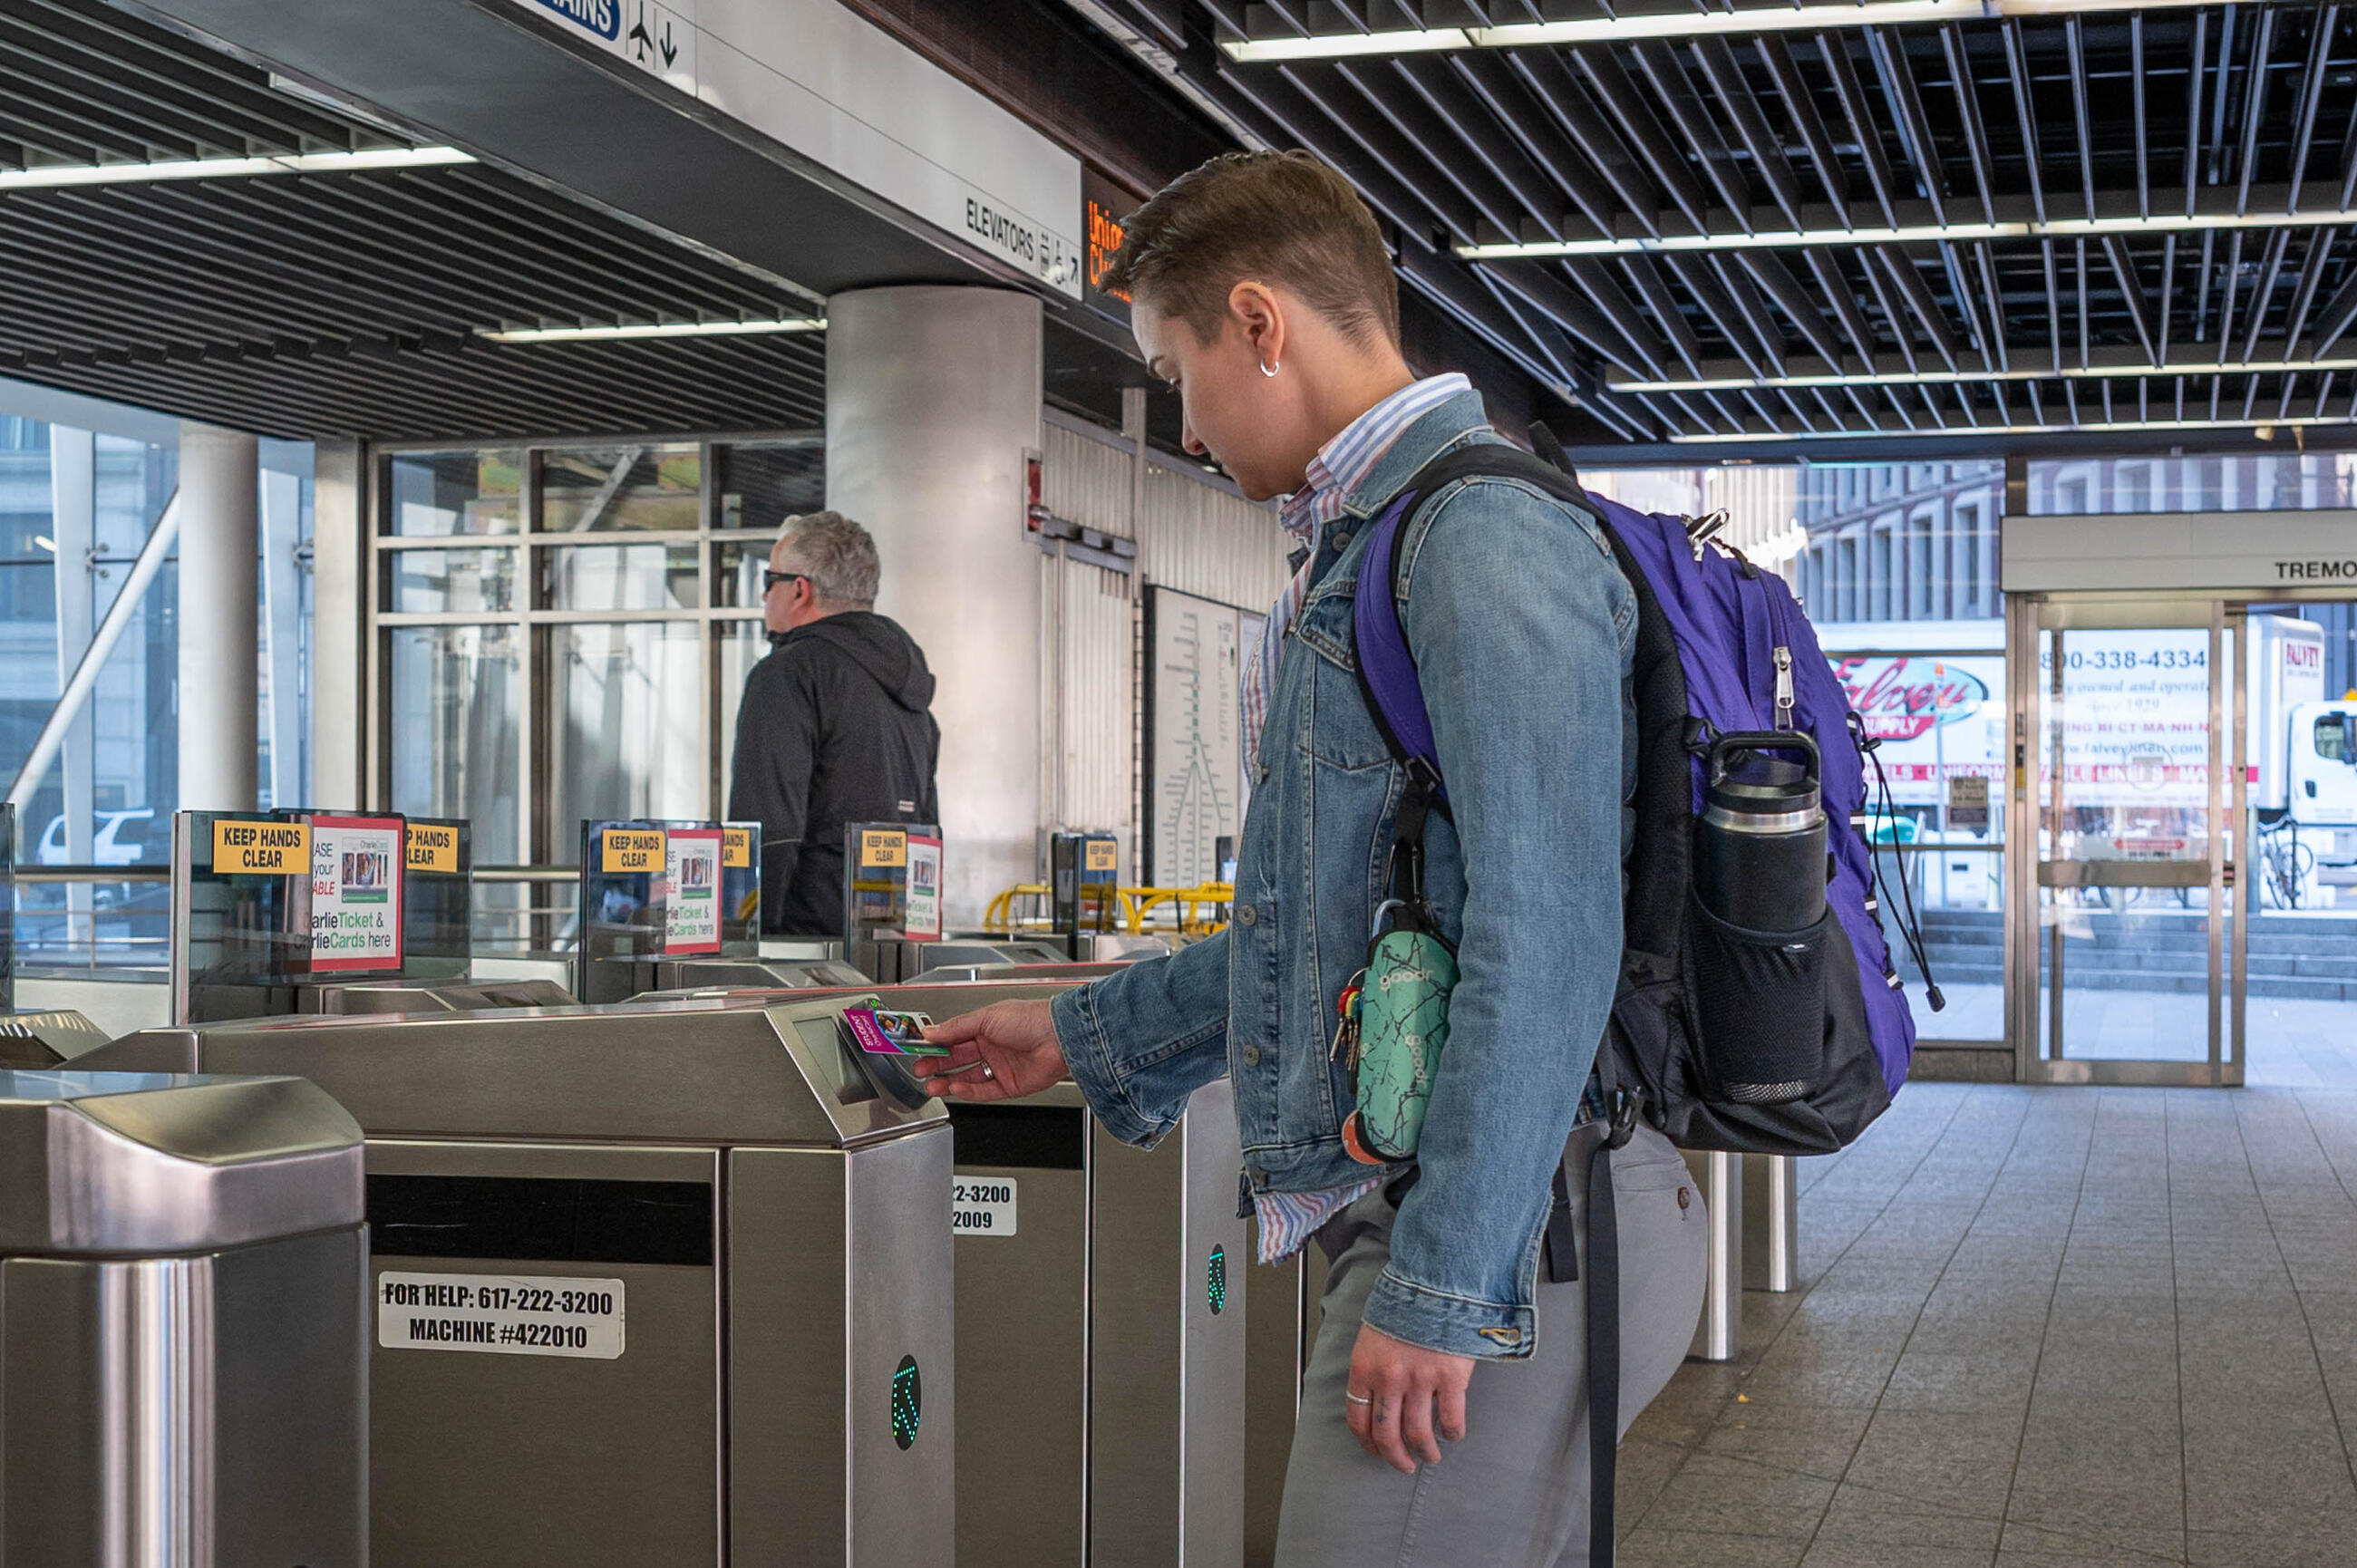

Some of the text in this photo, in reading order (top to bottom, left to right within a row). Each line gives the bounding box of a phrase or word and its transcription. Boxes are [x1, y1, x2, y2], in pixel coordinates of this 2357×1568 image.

[966, 198, 1033, 262] ELEVATORS
[1088, 200, 1125, 251] Unio
[224, 828, 301, 847] KEEP HANDS
[416, 830, 450, 848] HANDS
[609, 836, 660, 850] KEEP HANDS
[726, 834, 744, 847] ANDS
[242, 849, 283, 867] CLEAR
[315, 843, 333, 857] ASE
[408, 848, 434, 865] LEAR
[621, 852, 647, 867] CLEAR
[314, 864, 334, 878] your
[312, 880, 335, 895] ABLE
[311, 912, 384, 929] arlieTicket &
[368, 931, 391, 948] here
[1380, 968, 1433, 992] goodr
[1405, 1034, 1429, 1089] goodr
[953, 1185, 1011, 1204] 2-3200
[385, 1282, 613, 1315] FOR HELP: 617-222-3200
[410, 1318, 587, 1349] MACHINE #422010
